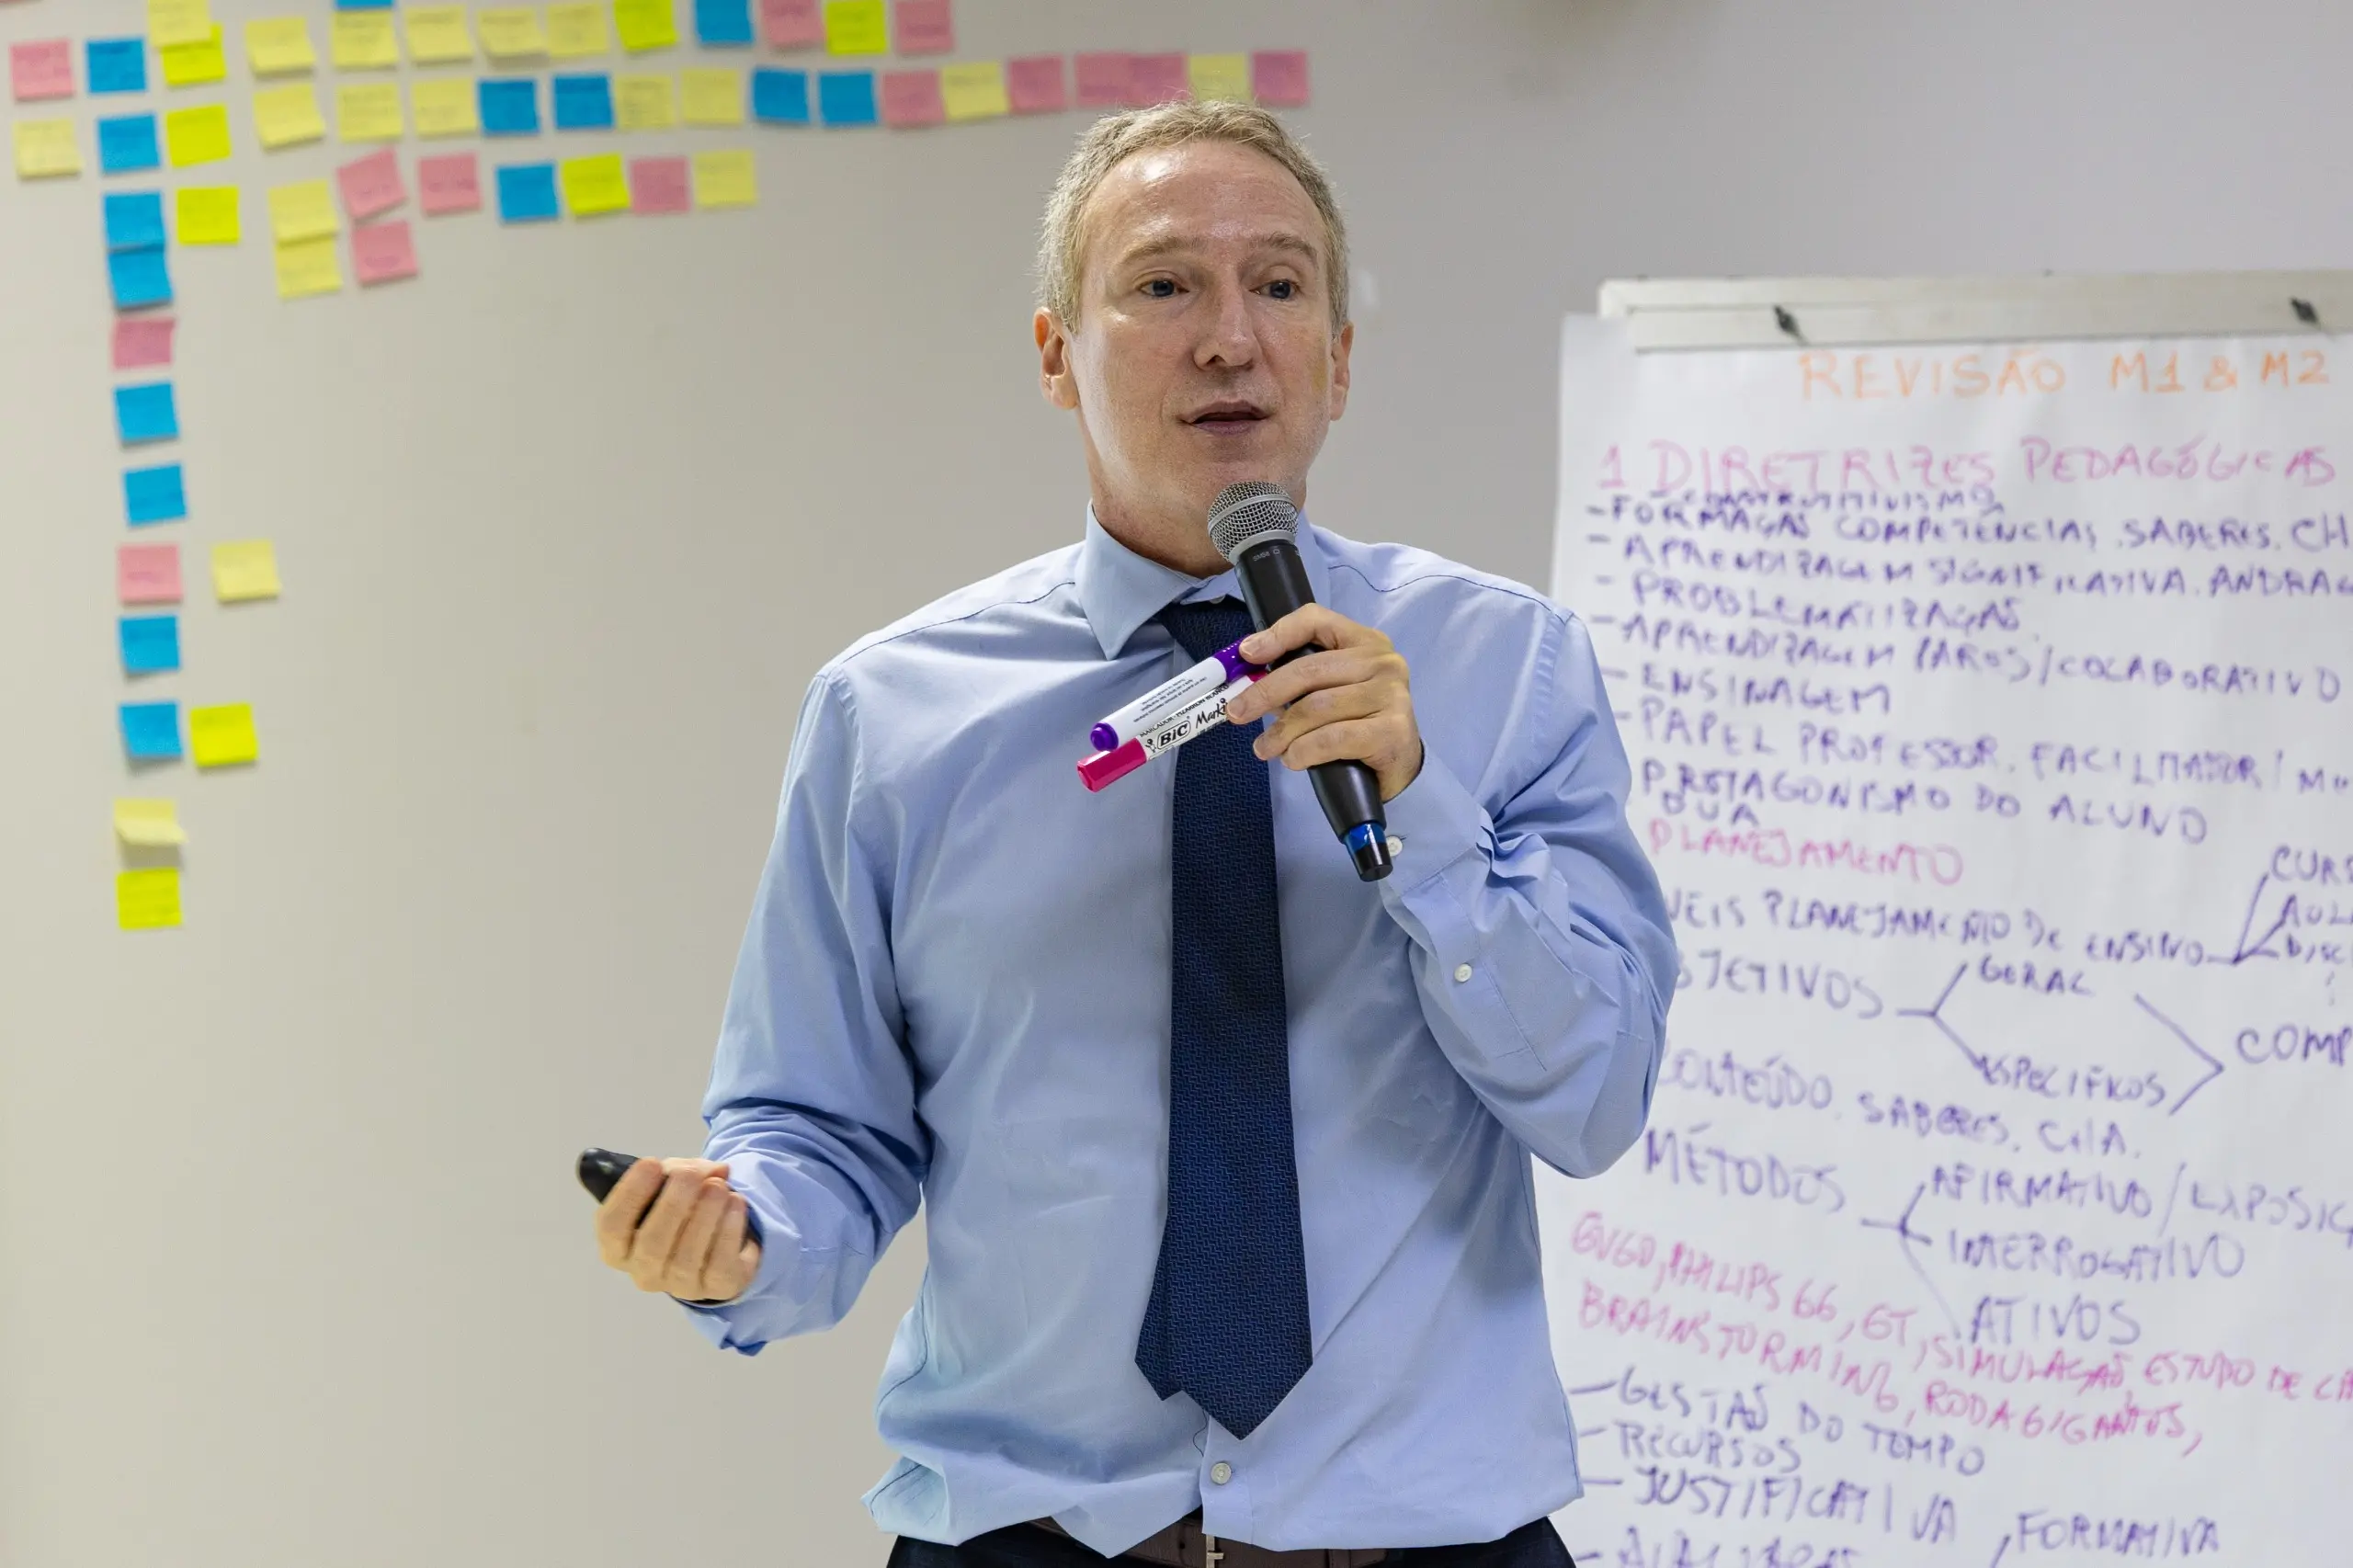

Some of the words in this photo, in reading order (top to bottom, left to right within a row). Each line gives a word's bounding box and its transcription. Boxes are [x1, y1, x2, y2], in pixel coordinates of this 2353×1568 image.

[1799, 348, 2066, 399] REVISÃO
[2109, 349, 2186, 393] M1
[2203, 355, 2237, 392] &
[2260, 348, 2330, 388] M2
[1640, 696, 1777, 756] PAPEL
[1975, 781, 2021, 818] DO
[2049, 792, 2208, 846] ALUNO
[1646, 1119, 1848, 1213] MÉTODOS
[1971, 1294, 2143, 1346] ATIVOS
[1799, 1401, 1844, 1443] DO
[1634, 1465, 1958, 1545] JUSTIFICATIVA
